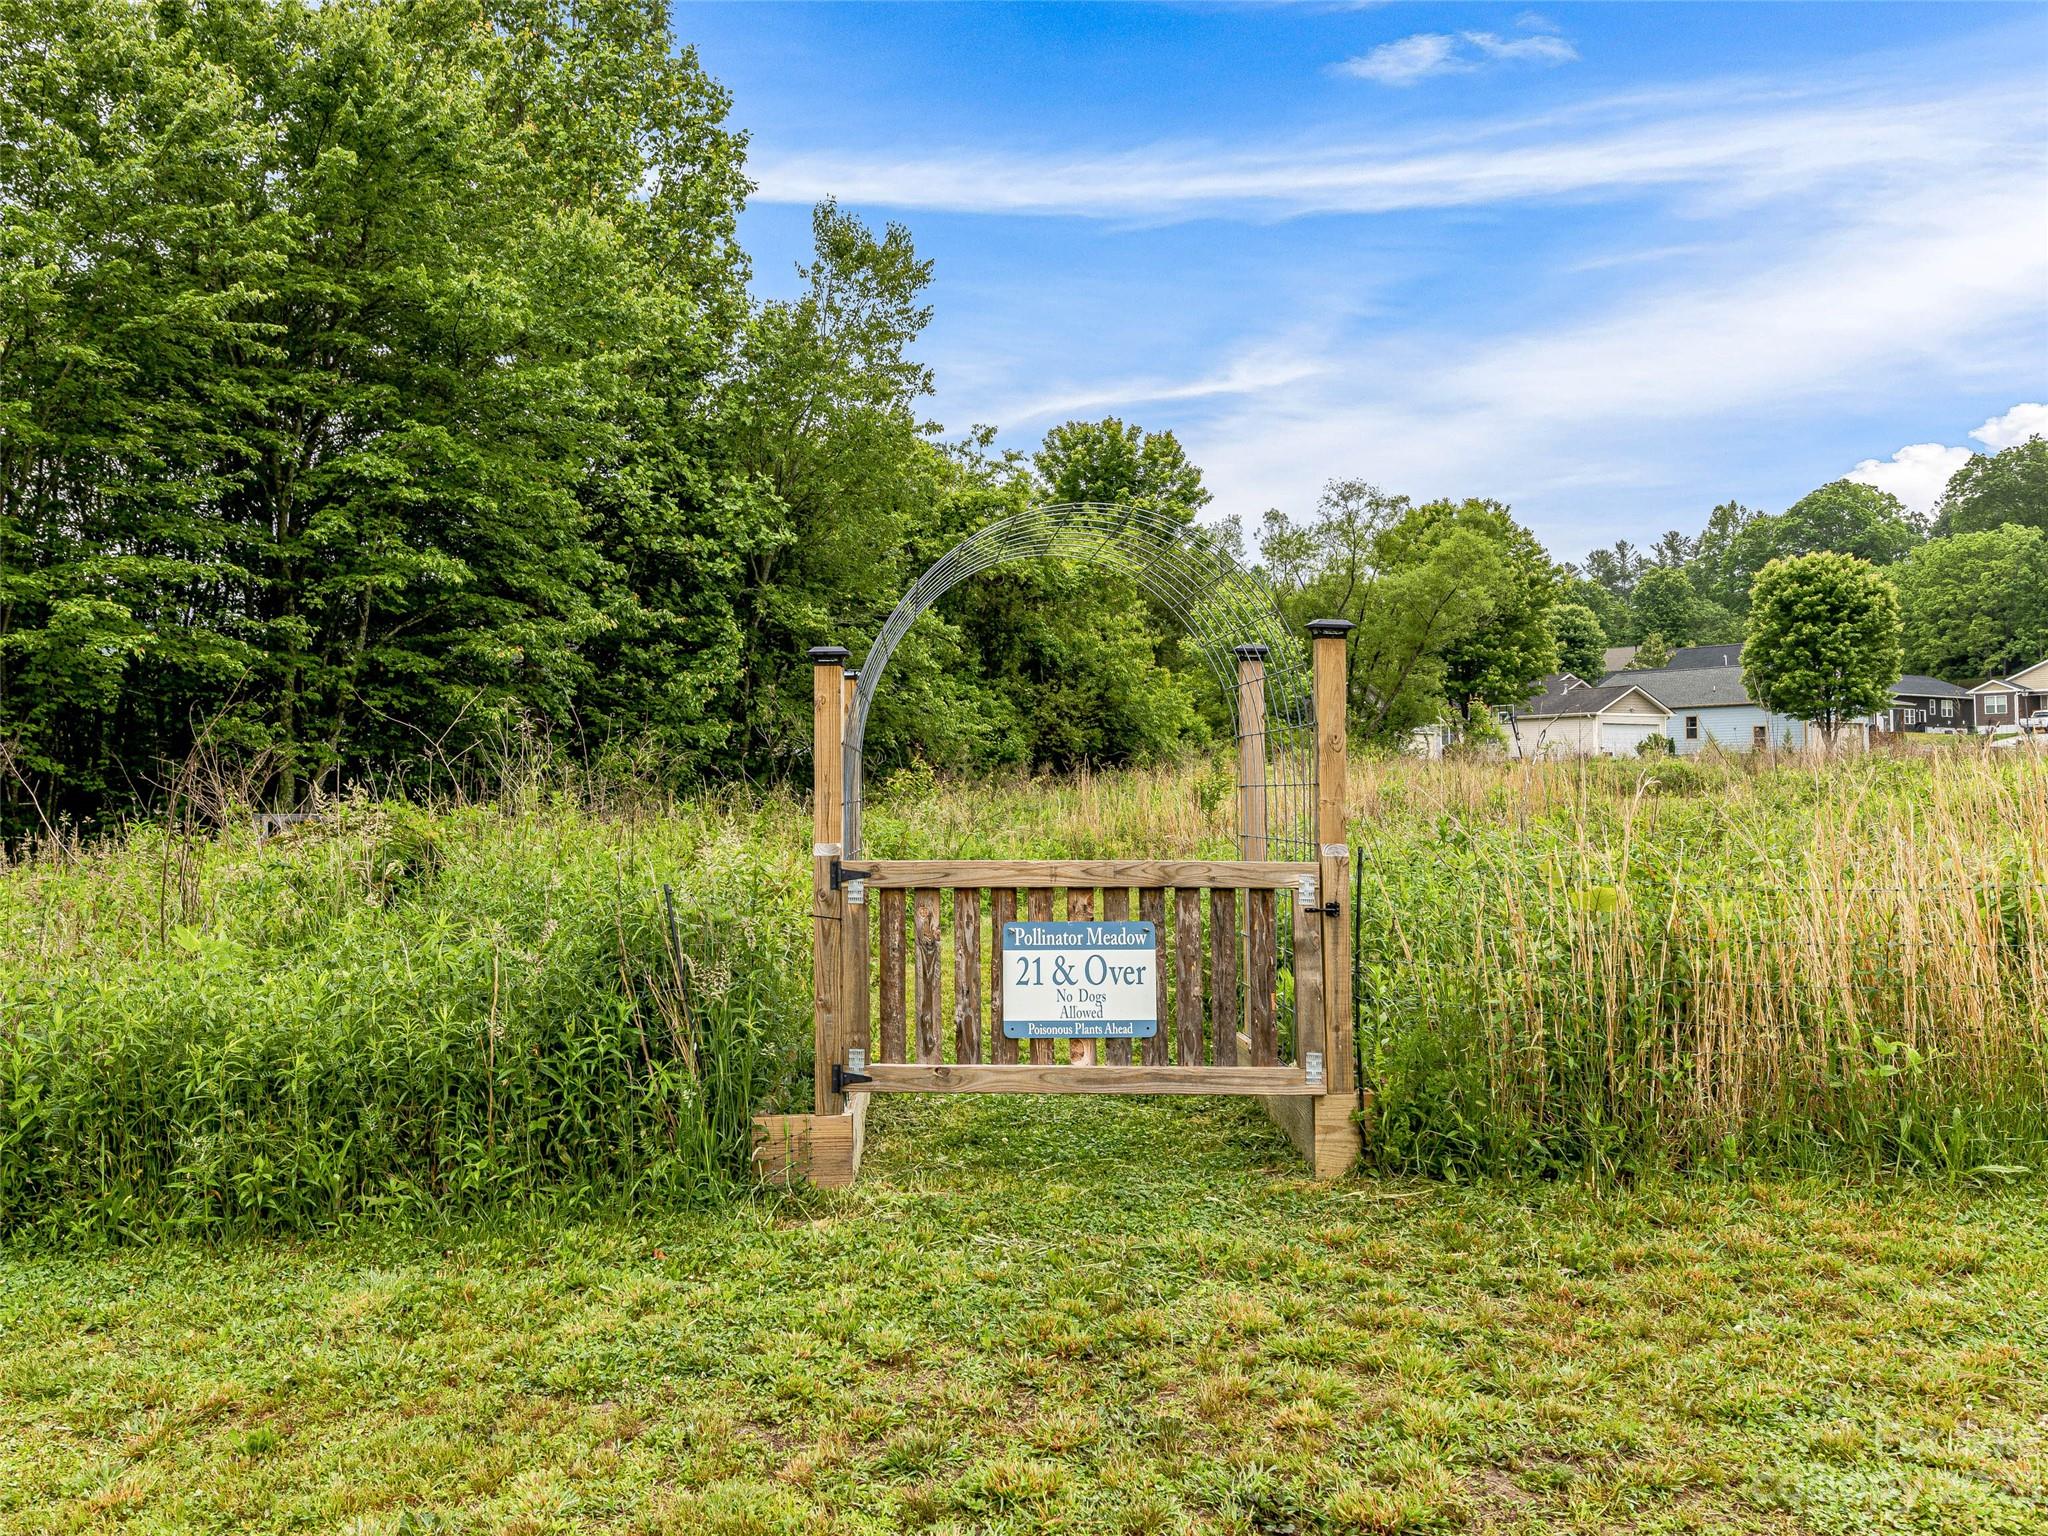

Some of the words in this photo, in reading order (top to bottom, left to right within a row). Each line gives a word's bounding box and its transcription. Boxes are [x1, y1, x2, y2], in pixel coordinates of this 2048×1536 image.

[1014, 927, 1084, 946] Pollinator
[1086, 926, 1148, 946] Meadow
[1015, 956, 1044, 986] 21
[1052, 955, 1079, 986] &
[1084, 954, 1147, 986] Over
[1056, 988, 1073, 1003] No
[1079, 988, 1107, 1007] Dogs
[1060, 1005, 1104, 1019] Allowed
[1028, 1023, 1073, 1035] Poisonous
[1075, 1023, 1103, 1035] Plants
[1104, 1023, 1133, 1035] Ahead
